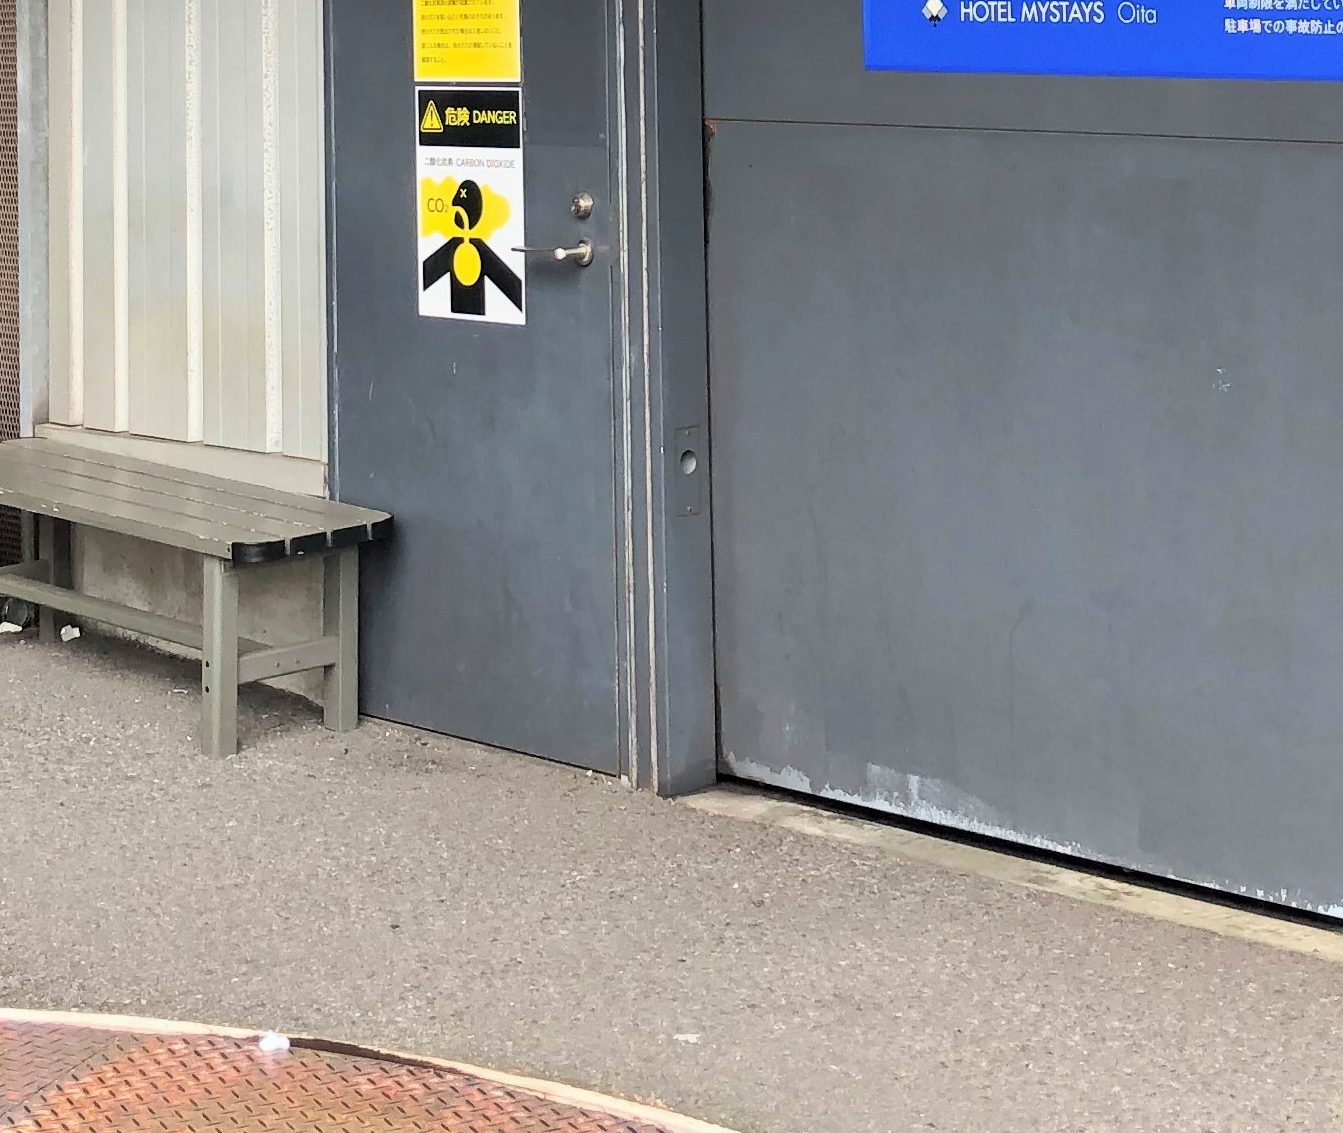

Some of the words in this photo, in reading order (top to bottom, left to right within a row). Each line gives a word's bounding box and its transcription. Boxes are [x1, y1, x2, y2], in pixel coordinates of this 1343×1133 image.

[960, 2, 1016, 22] HOTEL
[1020, 1, 1104, 23] MYSTAYS
[1117, 1, 1157, 24] Oita
[445, 107, 470, 126] 危険
[472, 110, 517, 124] DANGER
[456, 158, 485, 167] CARBON
